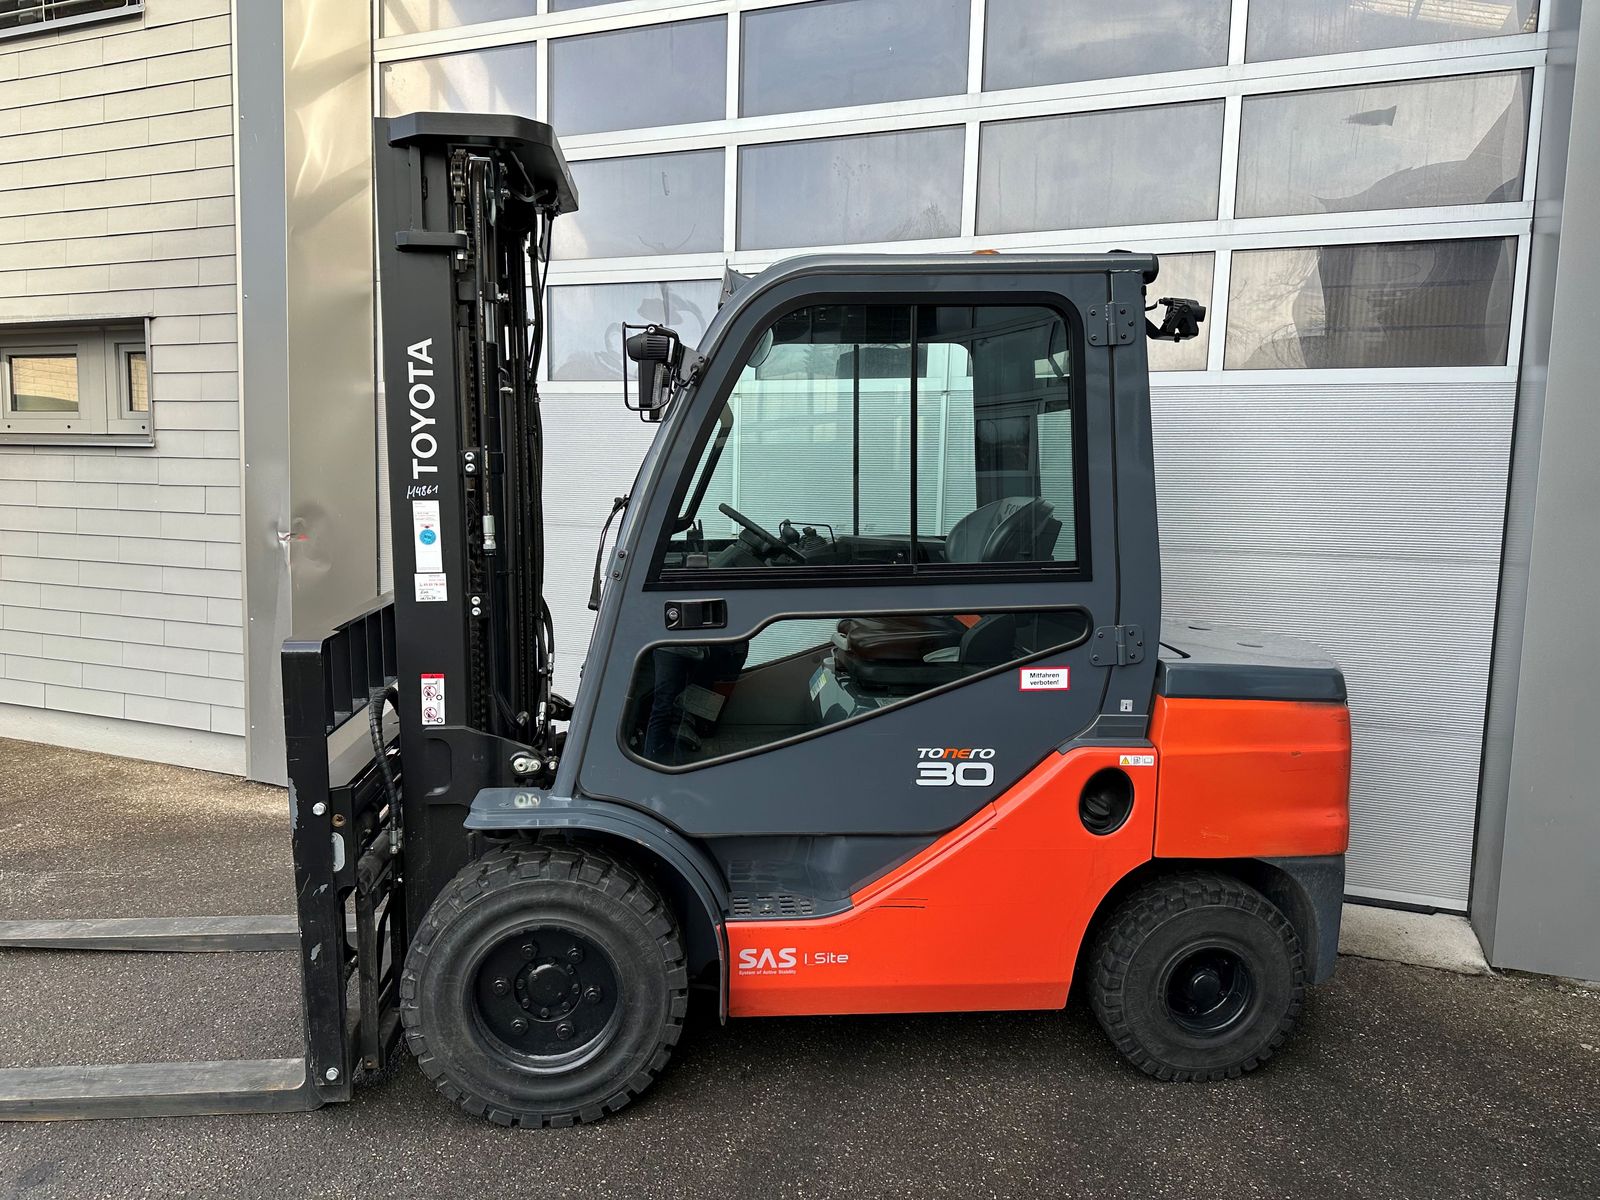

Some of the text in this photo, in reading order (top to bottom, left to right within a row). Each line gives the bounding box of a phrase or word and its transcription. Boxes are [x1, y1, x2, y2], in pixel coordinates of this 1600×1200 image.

[407, 337, 438, 479] TOYOTA
[915, 761, 995, 787] 30
[738, 948, 797, 969] SAS
